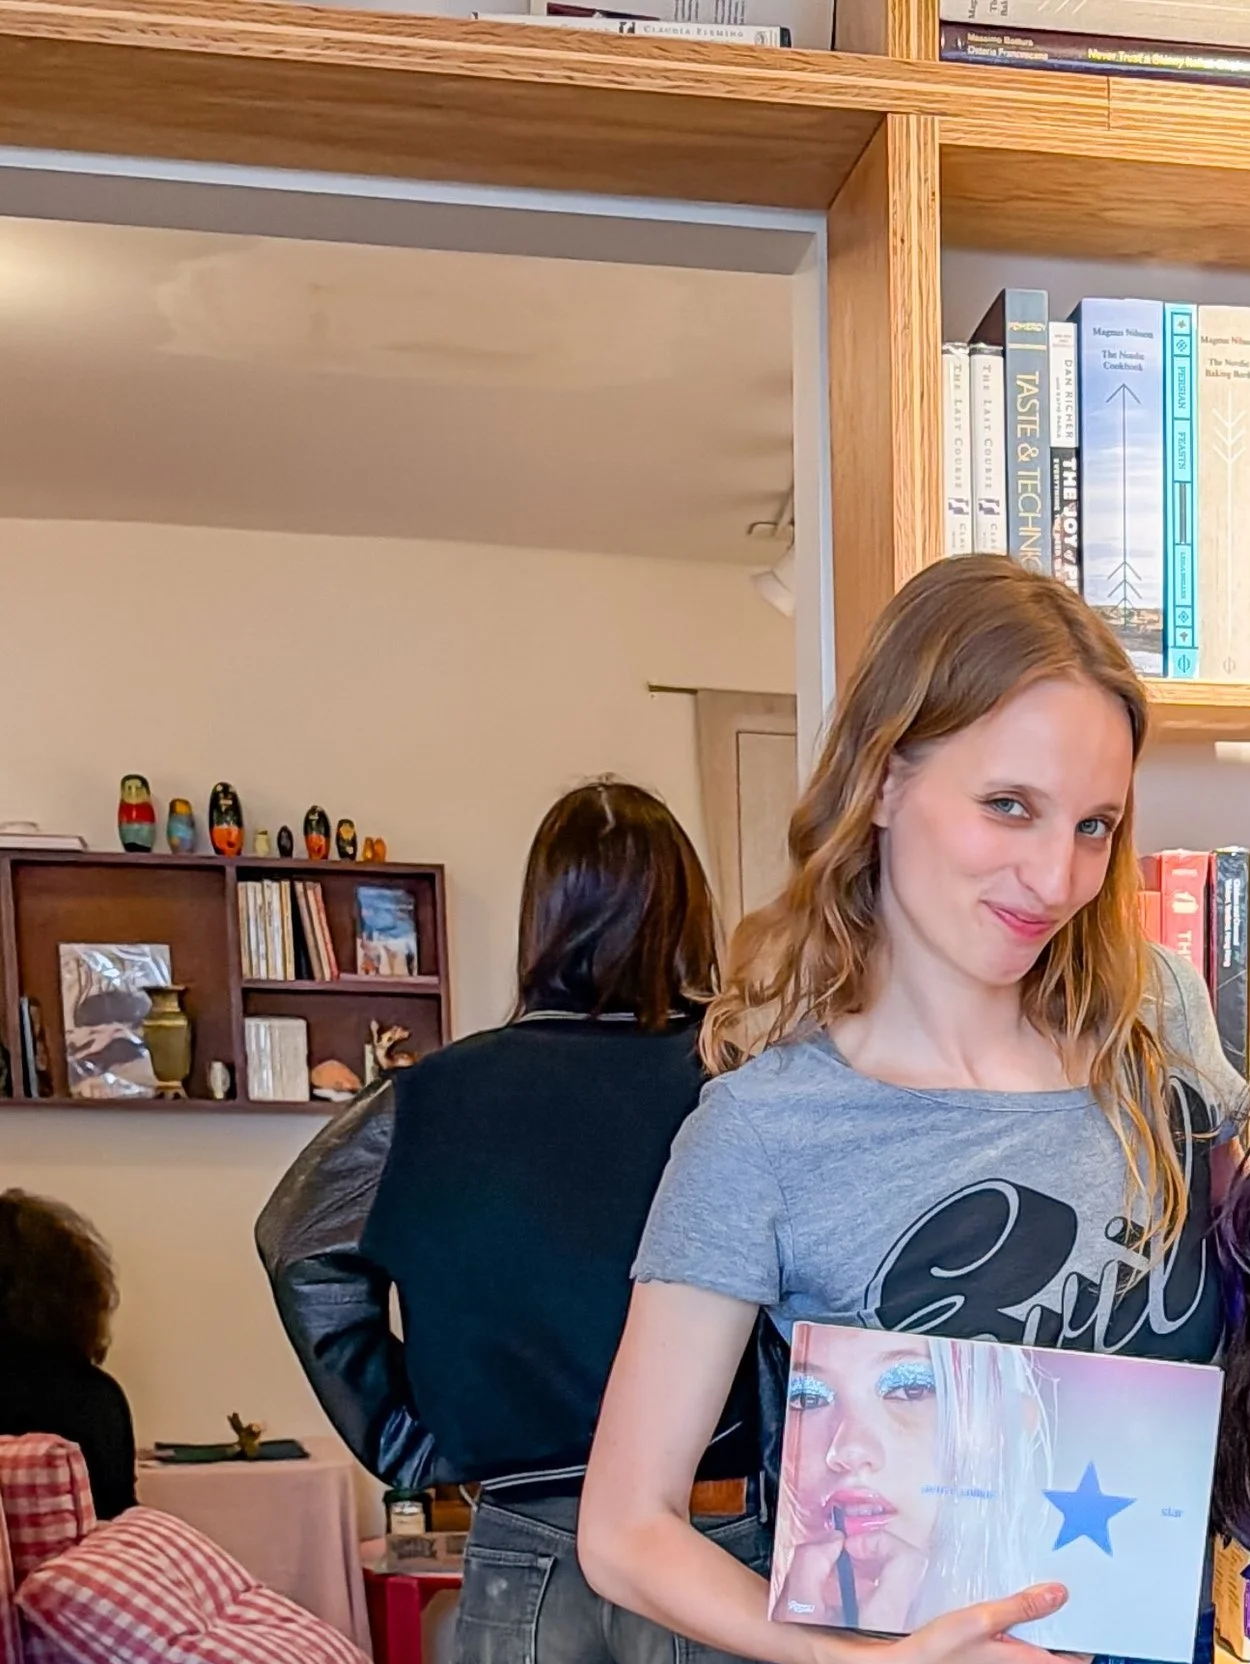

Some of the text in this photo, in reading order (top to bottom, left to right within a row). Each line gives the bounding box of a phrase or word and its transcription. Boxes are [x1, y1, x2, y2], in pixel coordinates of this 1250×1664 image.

[1092, 326, 1123, 340] Magnus
[1200, 335, 1230, 347] Magnus
[1101, 349, 1145, 362] The Nordic
[1208, 357, 1250, 369] The Nordic
[1102, 360, 1144, 373] Cookbook
[1205, 367, 1232, 380] Baking
[1015, 372, 1040, 439] TASTE
[1064, 359, 1074, 439] DAN RICHER
[953, 364, 964, 490] THE LAST COURSE
[983, 364, 993, 490] THE LAST COURSE
[1176, 365, 1187, 471] PERSIAN FEASTS
[1017, 443, 1039, 463] &
[1062, 457, 1077, 499] THE
